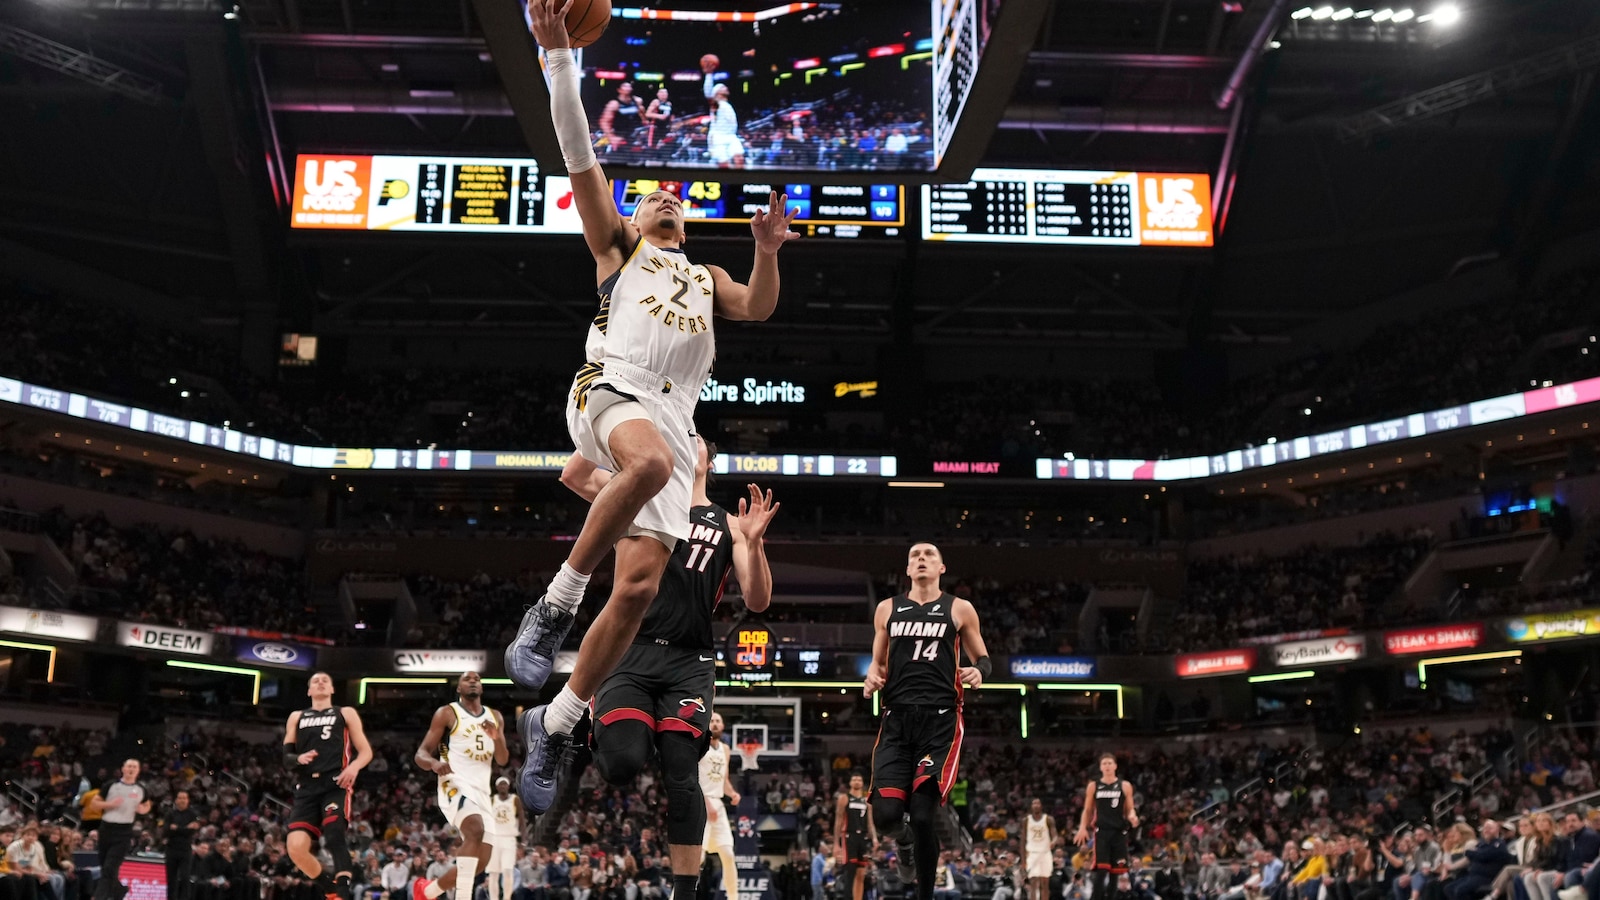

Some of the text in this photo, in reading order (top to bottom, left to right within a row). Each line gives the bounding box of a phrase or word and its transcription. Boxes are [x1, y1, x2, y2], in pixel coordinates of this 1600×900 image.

[688, 181, 721, 200] 43
[793, 185, 803, 195] 4
[641, 256, 712, 297] INDIANA
[670, 274, 689, 310] 2
[640, 295, 707, 335] PACERS
[700, 378, 739, 402] Sire
[743, 377, 805, 405] Spirits
[496, 455, 543, 466] INDIANA
[734, 456, 778, 472] 10:08
[847, 459, 868, 473] 22
[933, 461, 1000, 474] MIAMI HEAT
[685, 544, 715, 573] 11
[739, 630, 769, 644] 10:08
[890, 621, 947, 637] MIAMI
[144, 629, 202, 651] DEEM
[1387, 635, 1427, 649] STEAK
[1436, 629, 1479, 645] SHAKE
[260, 643, 289, 660] Ford
[912, 640, 939, 661] 14
[1277, 644, 1332, 662] KeyBank
[1011, 659, 1094, 675] ticketmaster
[299, 716, 337, 729] MIAMI
[320, 726, 332, 740] 5
[475, 735, 484, 751] 5
[1096, 790, 1121, 799] MIAMI
